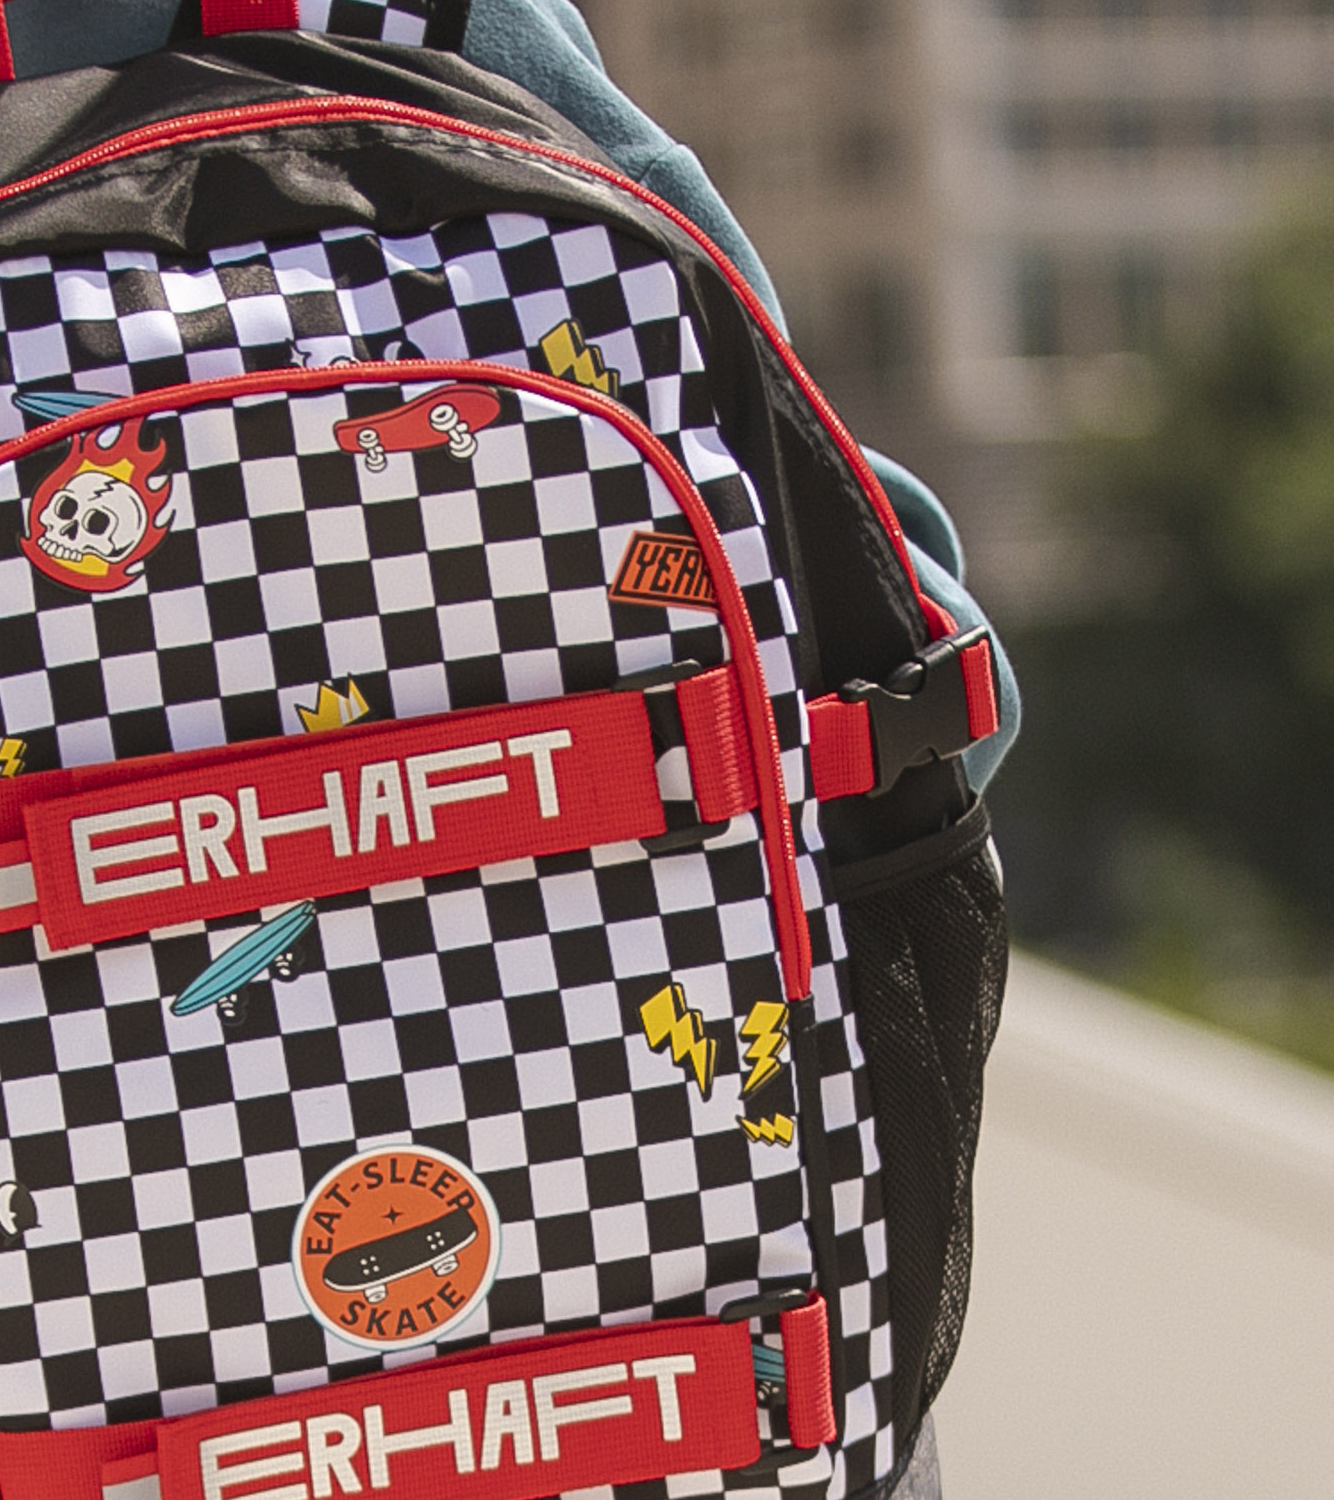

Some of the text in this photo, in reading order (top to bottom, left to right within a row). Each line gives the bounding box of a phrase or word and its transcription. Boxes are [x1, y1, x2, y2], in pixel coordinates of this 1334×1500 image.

[70, 729, 573, 906] ERHAFT
[306, 1158, 476, 1256] EAT-SLEEP
[339, 1281, 466, 1336] SKATE
